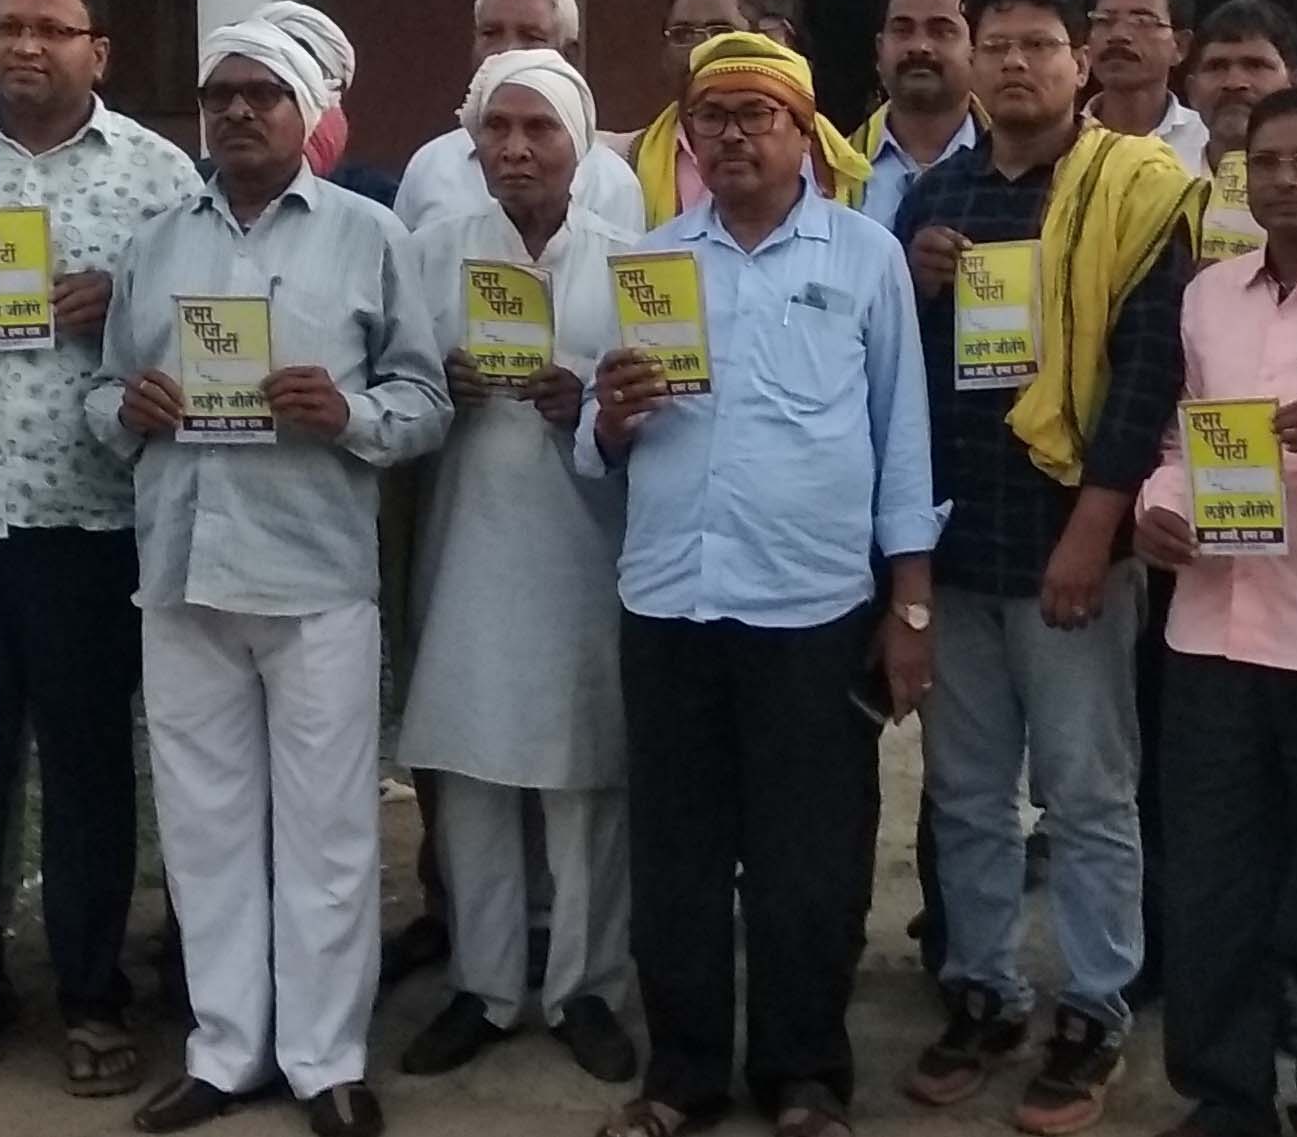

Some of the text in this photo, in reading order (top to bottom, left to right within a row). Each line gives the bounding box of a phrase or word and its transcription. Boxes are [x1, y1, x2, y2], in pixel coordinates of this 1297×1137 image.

[961, 256, 984, 273] हमर
[471, 271, 499, 287] हमर
[616, 268, 645, 286] हमर
[182, 306, 212, 324] हमर
[1190, 412, 1221, 430] हमर
